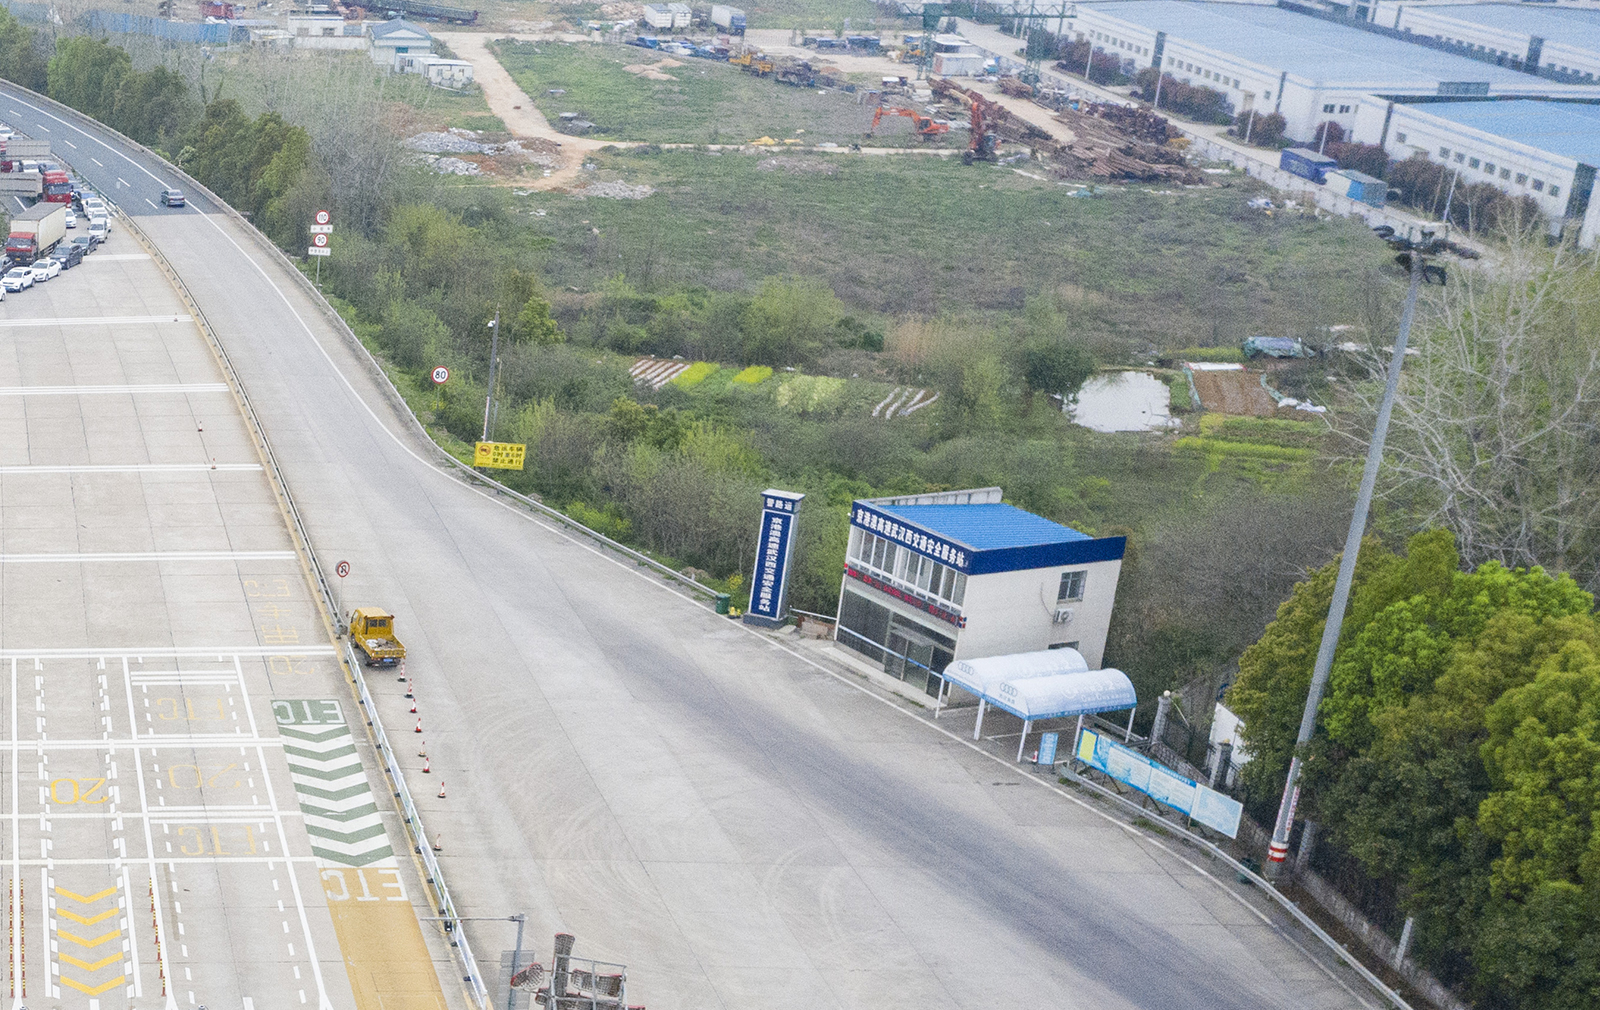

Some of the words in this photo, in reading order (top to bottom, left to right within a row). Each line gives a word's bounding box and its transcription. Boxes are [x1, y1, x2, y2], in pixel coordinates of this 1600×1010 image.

[435, 371, 446, 379] 80
[856, 509, 966, 567] 京港澳高速武汉西交通安全服务站
[758, 517, 783, 612] 京港澳高速武汉西交通安全服务站
[271, 700, 346, 724] ETC
[50, 777, 108, 805] 20
[321, 868, 409, 902] ETC
